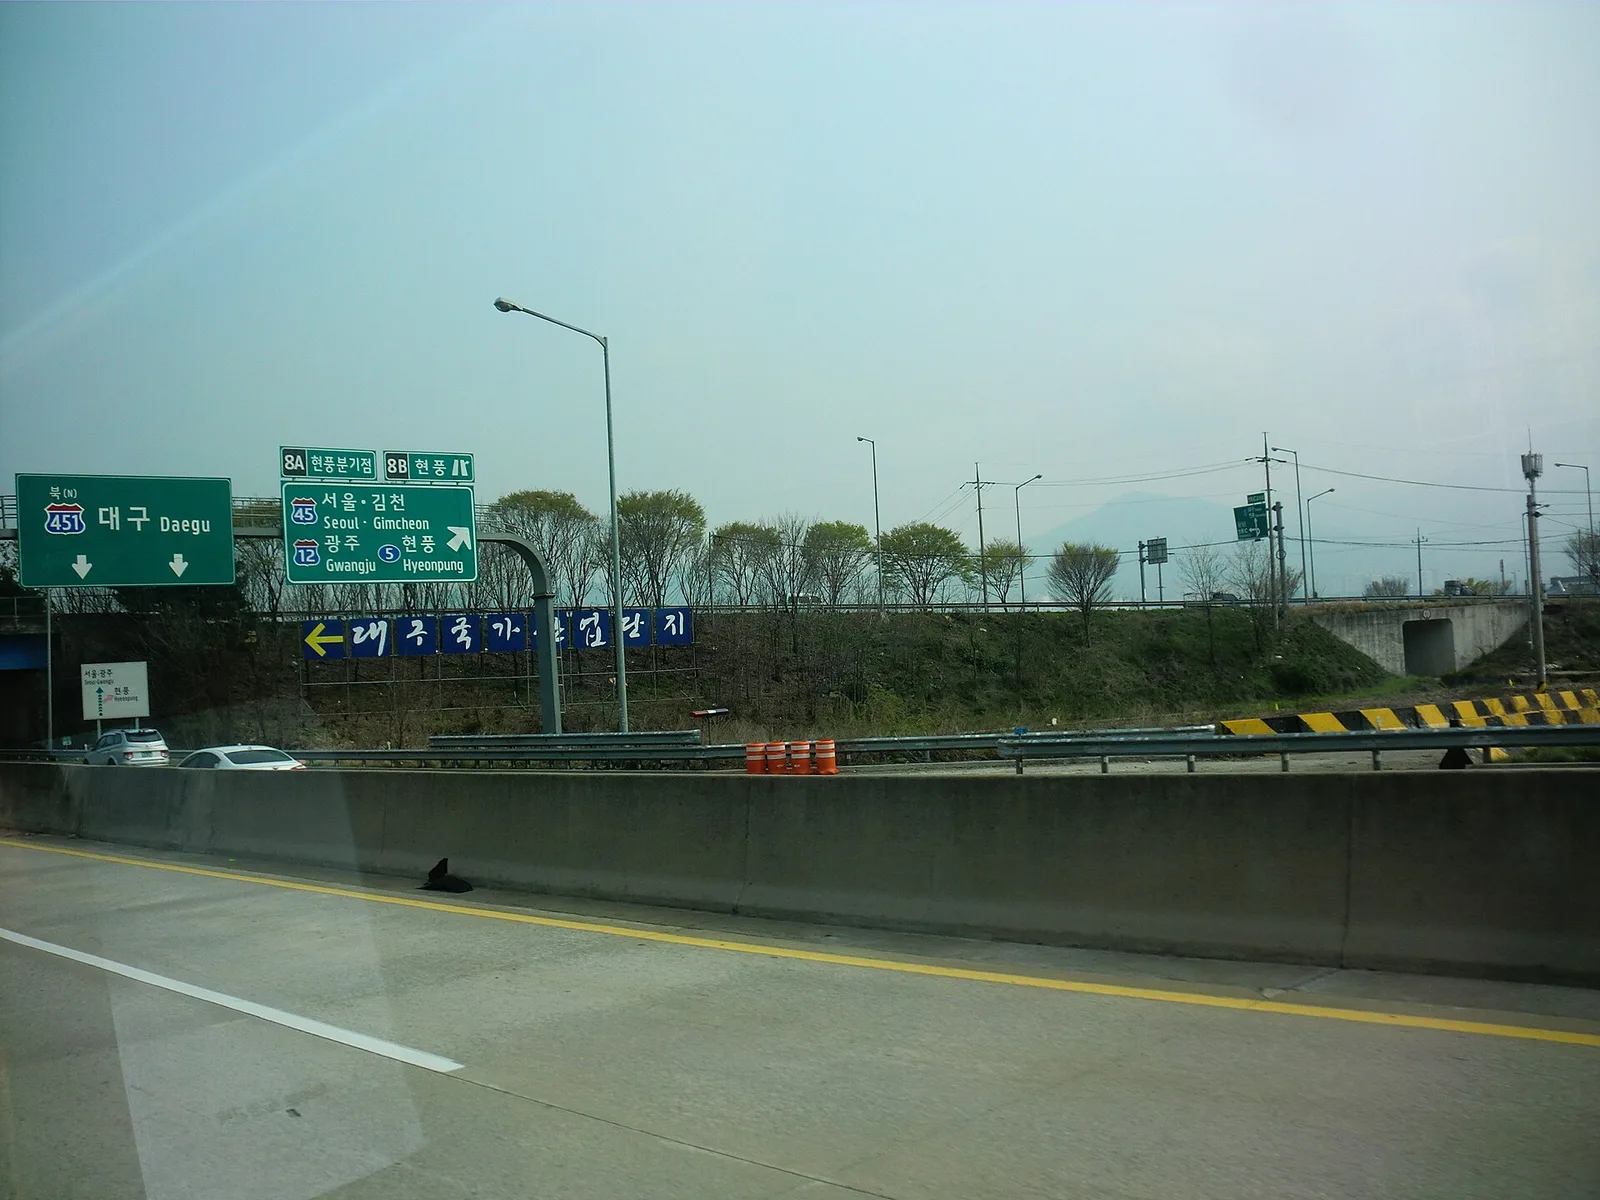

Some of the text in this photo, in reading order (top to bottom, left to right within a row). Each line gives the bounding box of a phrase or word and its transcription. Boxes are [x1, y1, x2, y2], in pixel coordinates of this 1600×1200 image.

[284, 454, 305, 471] 8A
[311, 454, 372, 474] 현풍분기점
[387, 458, 407, 473] 8B
[414, 458, 447, 477] 현풍
[50, 513, 80, 531] 451
[98, 506, 150, 531] 대구
[294, 507, 314, 521] 45
[160, 516, 211, 536] Daegu
[373, 516, 429, 530] Gimcheon
[324, 535, 360, 554] 광주
[401, 535, 436, 554] 현풍
[298, 549, 315, 563] 12
[385, 547, 393, 560] 5
[326, 559, 376, 574] Gwangju
[403, 559, 464, 574] Hyeonpung
[114, 686, 130, 696] 현풍
